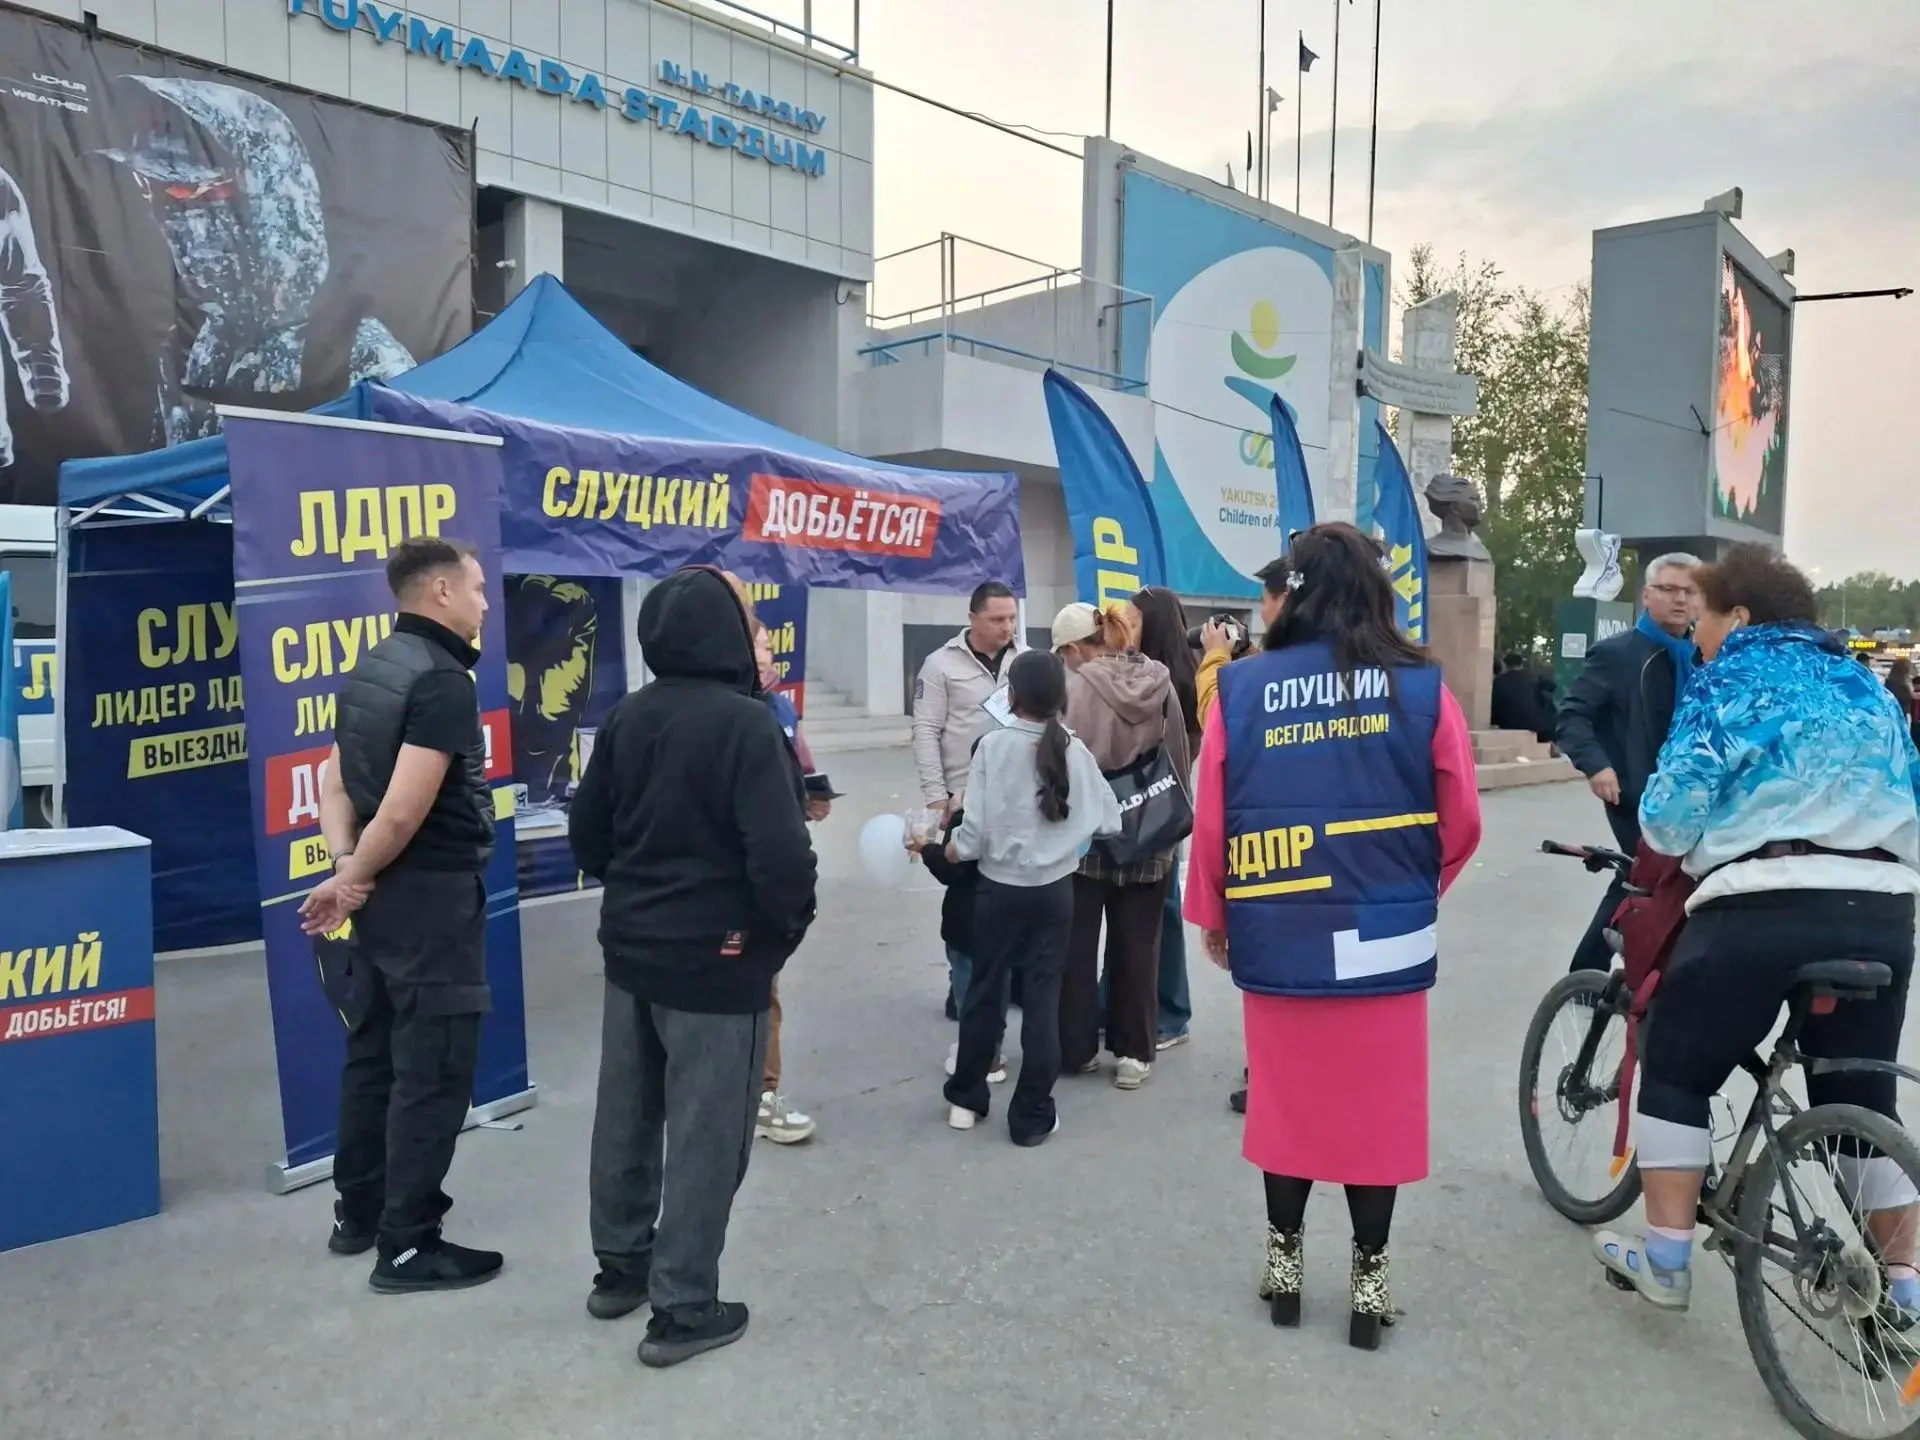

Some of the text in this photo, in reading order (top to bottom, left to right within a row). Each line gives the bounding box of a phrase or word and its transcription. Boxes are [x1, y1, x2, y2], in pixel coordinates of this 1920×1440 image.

[724, 81, 826, 134] TARSKY
[620, 86, 826, 177] STADIUM
[542, 466, 930, 548] СЛУЦКИЙ ДОБЬЁТСЯ!
[1219, 507, 1260, 526] Children
[1261, 513, 1272, 528] of
[1220, 486, 1268, 507] YAKUTSK
[290, 484, 457, 563] ЛДПР
[91, 682, 196, 728] ЛИДЕР
[143, 728, 248, 770] ВЫЕЗДН
[1265, 721, 1325, 749] ВСЕГДА
[5, 996, 127, 1039] ДОБЬЁТСЯ!
[391, 1247, 418, 1268] PUMA
